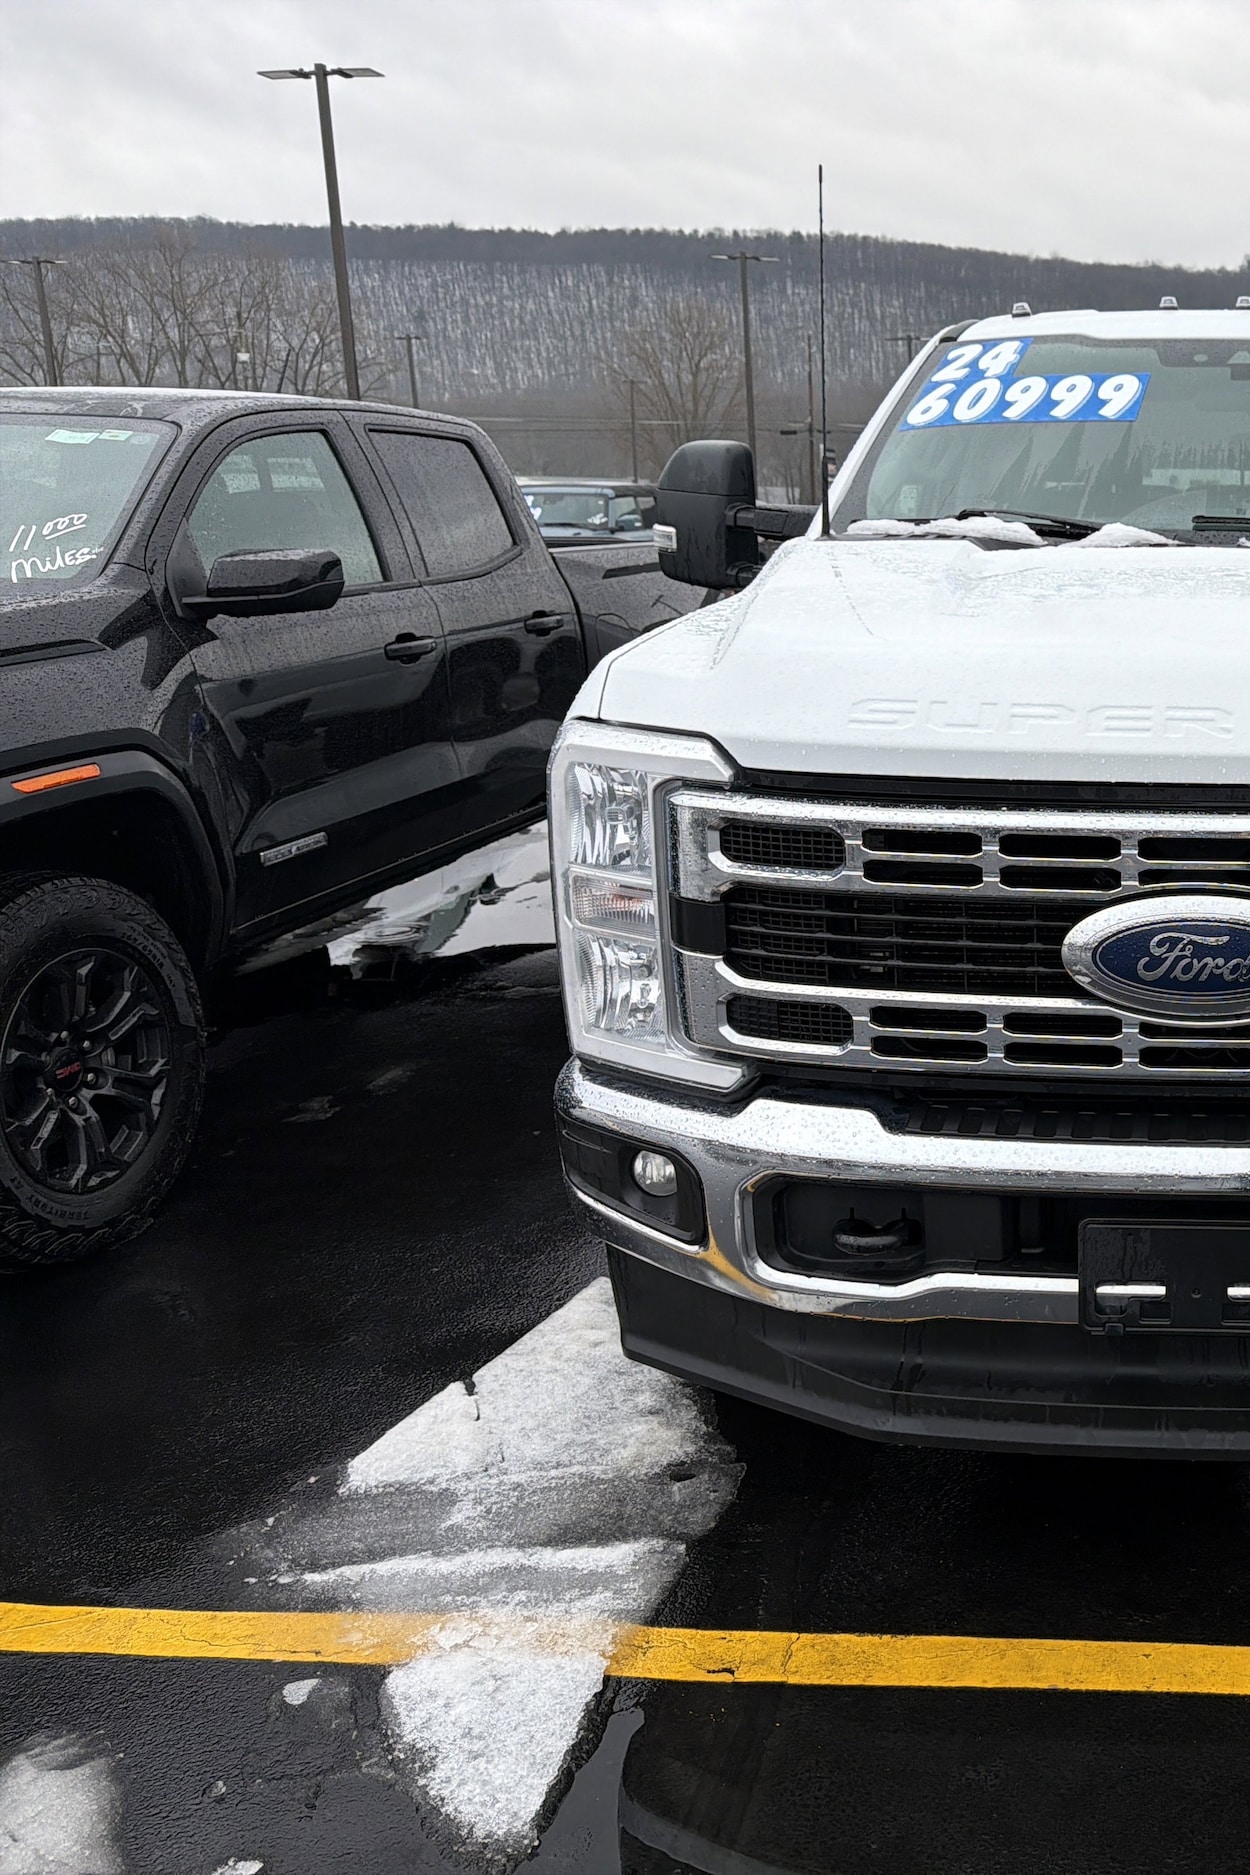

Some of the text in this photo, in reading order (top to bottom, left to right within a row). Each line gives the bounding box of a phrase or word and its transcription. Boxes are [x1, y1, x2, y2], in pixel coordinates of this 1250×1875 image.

[930, 341, 1023, 383] 24
[906, 374, 1142, 426] 60999
[848, 698, 1234, 739] SUPER
